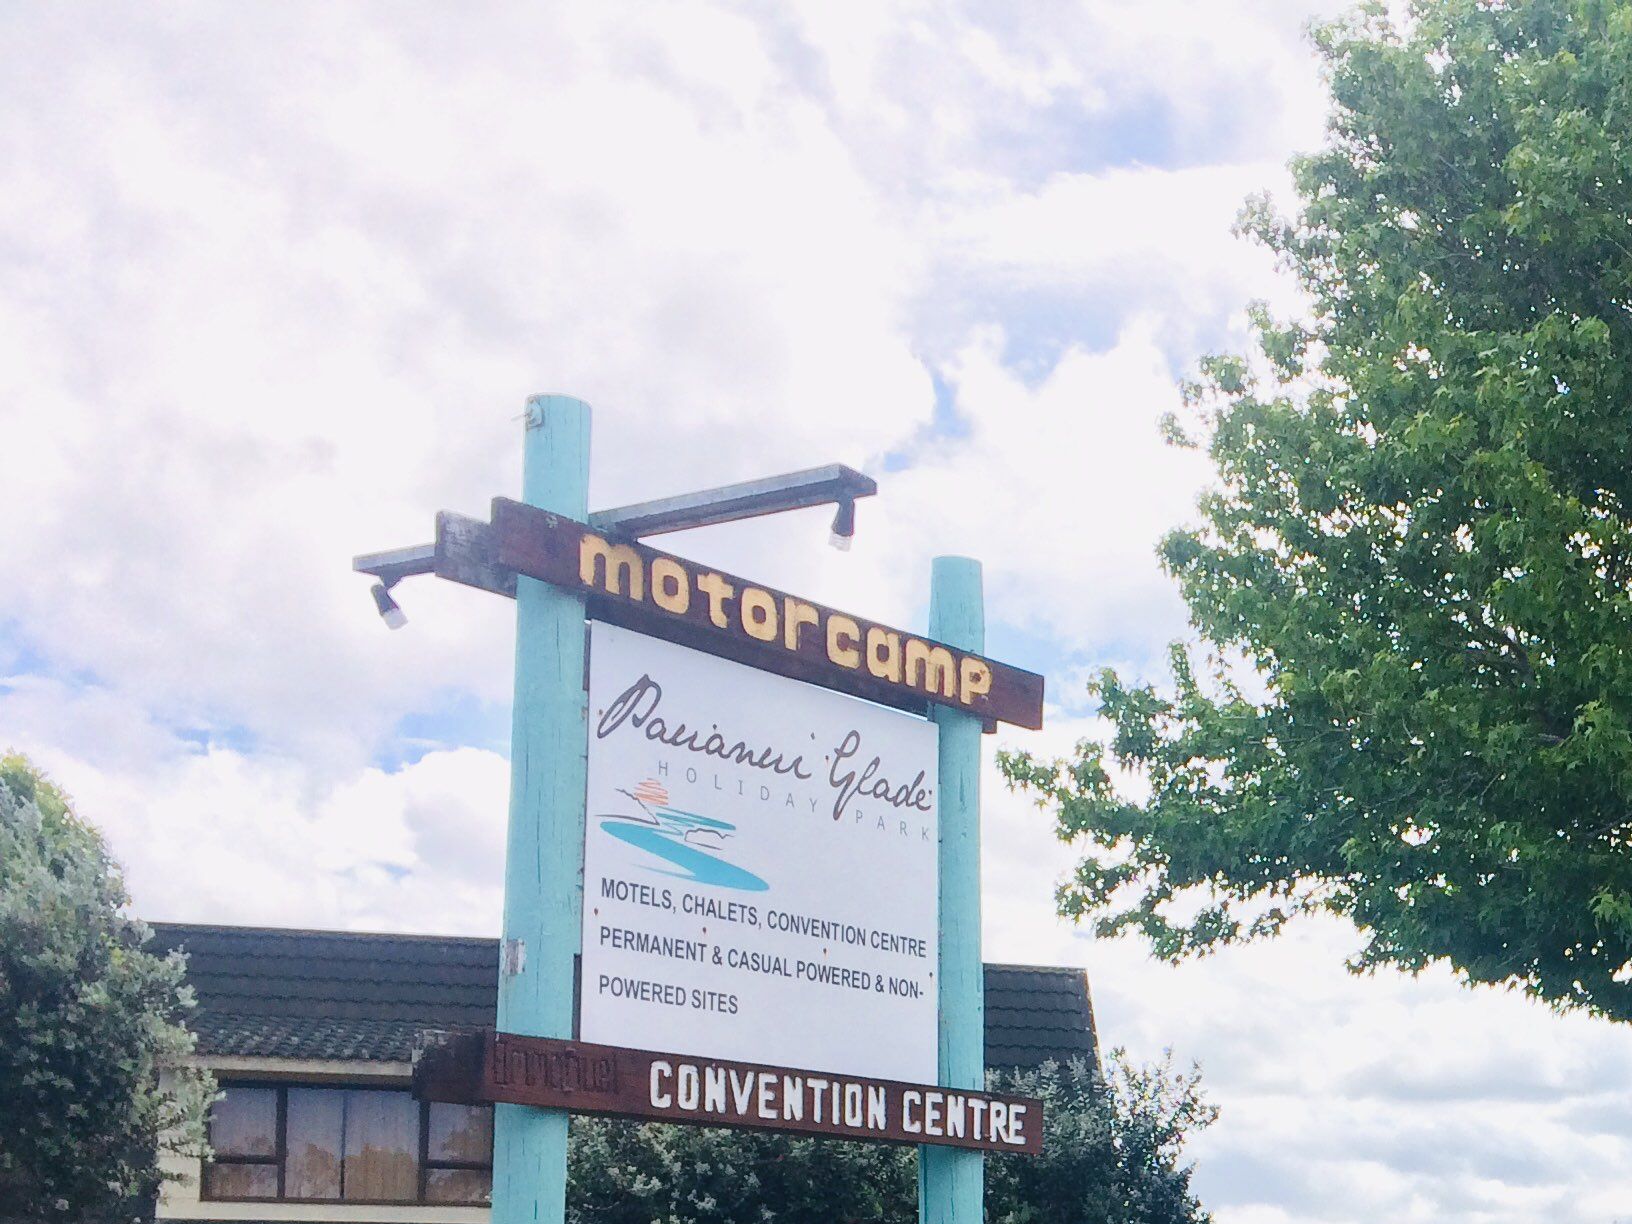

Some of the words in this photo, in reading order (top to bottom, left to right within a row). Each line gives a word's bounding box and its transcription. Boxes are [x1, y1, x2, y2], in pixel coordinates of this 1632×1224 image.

[579, 533, 993, 706] motorcamp
[596, 673, 816, 780] Pauanui
[829, 730, 933, 821] Glade
[658, 760, 818, 814] HOLIDAY
[856, 809, 930, 841] PARK
[601, 877, 677, 913] MOTELS,
[682, 893, 763, 930] CHALETS,
[767, 910, 867, 946] CONVENTION
[870, 930, 927, 958] CENTRE
[599, 974, 687, 1007] POWERED
[691, 989, 739, 1015] SITES
[600, 926, 707, 963] PERMANENT
[712, 946, 723, 966] &
[727, 948, 793, 978] CASUAL
[796, 960, 871, 991] POWERED
[875, 974, 885, 993] &
[889, 976, 924, 999] NON-
[649, 1059, 888, 1131] CONVENTION
[902, 1090, 1027, 1145] CENTRE
